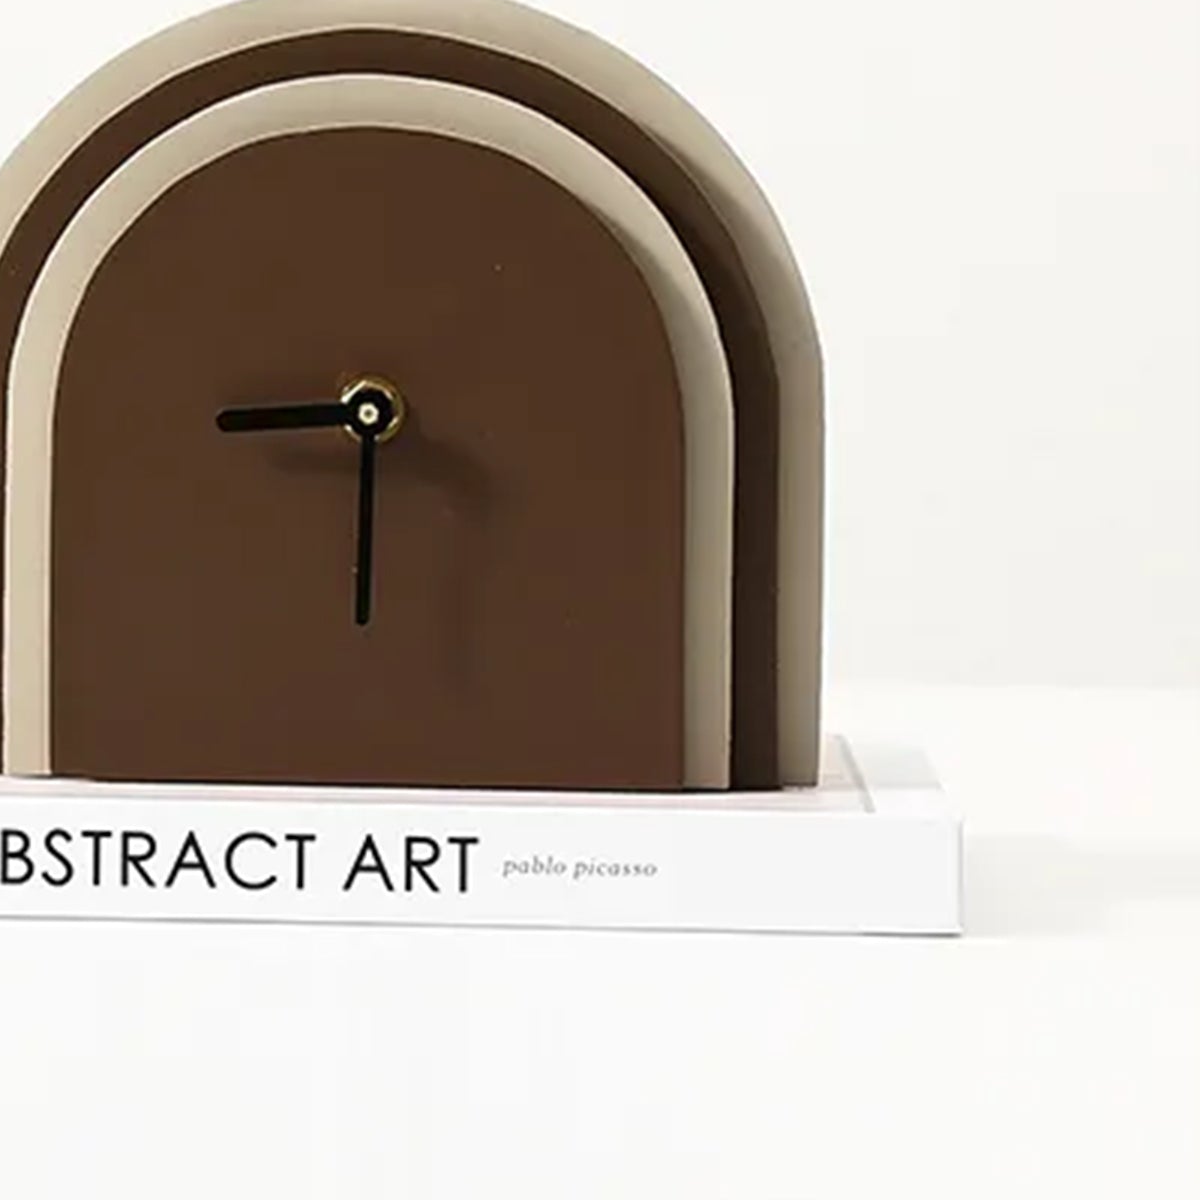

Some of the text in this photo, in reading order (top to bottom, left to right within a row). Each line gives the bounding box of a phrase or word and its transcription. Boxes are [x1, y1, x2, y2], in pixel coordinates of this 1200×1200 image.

[342, 834, 479, 893] ART
[502, 855, 567, 878] pablo
[572, 858, 658, 880] picasso
